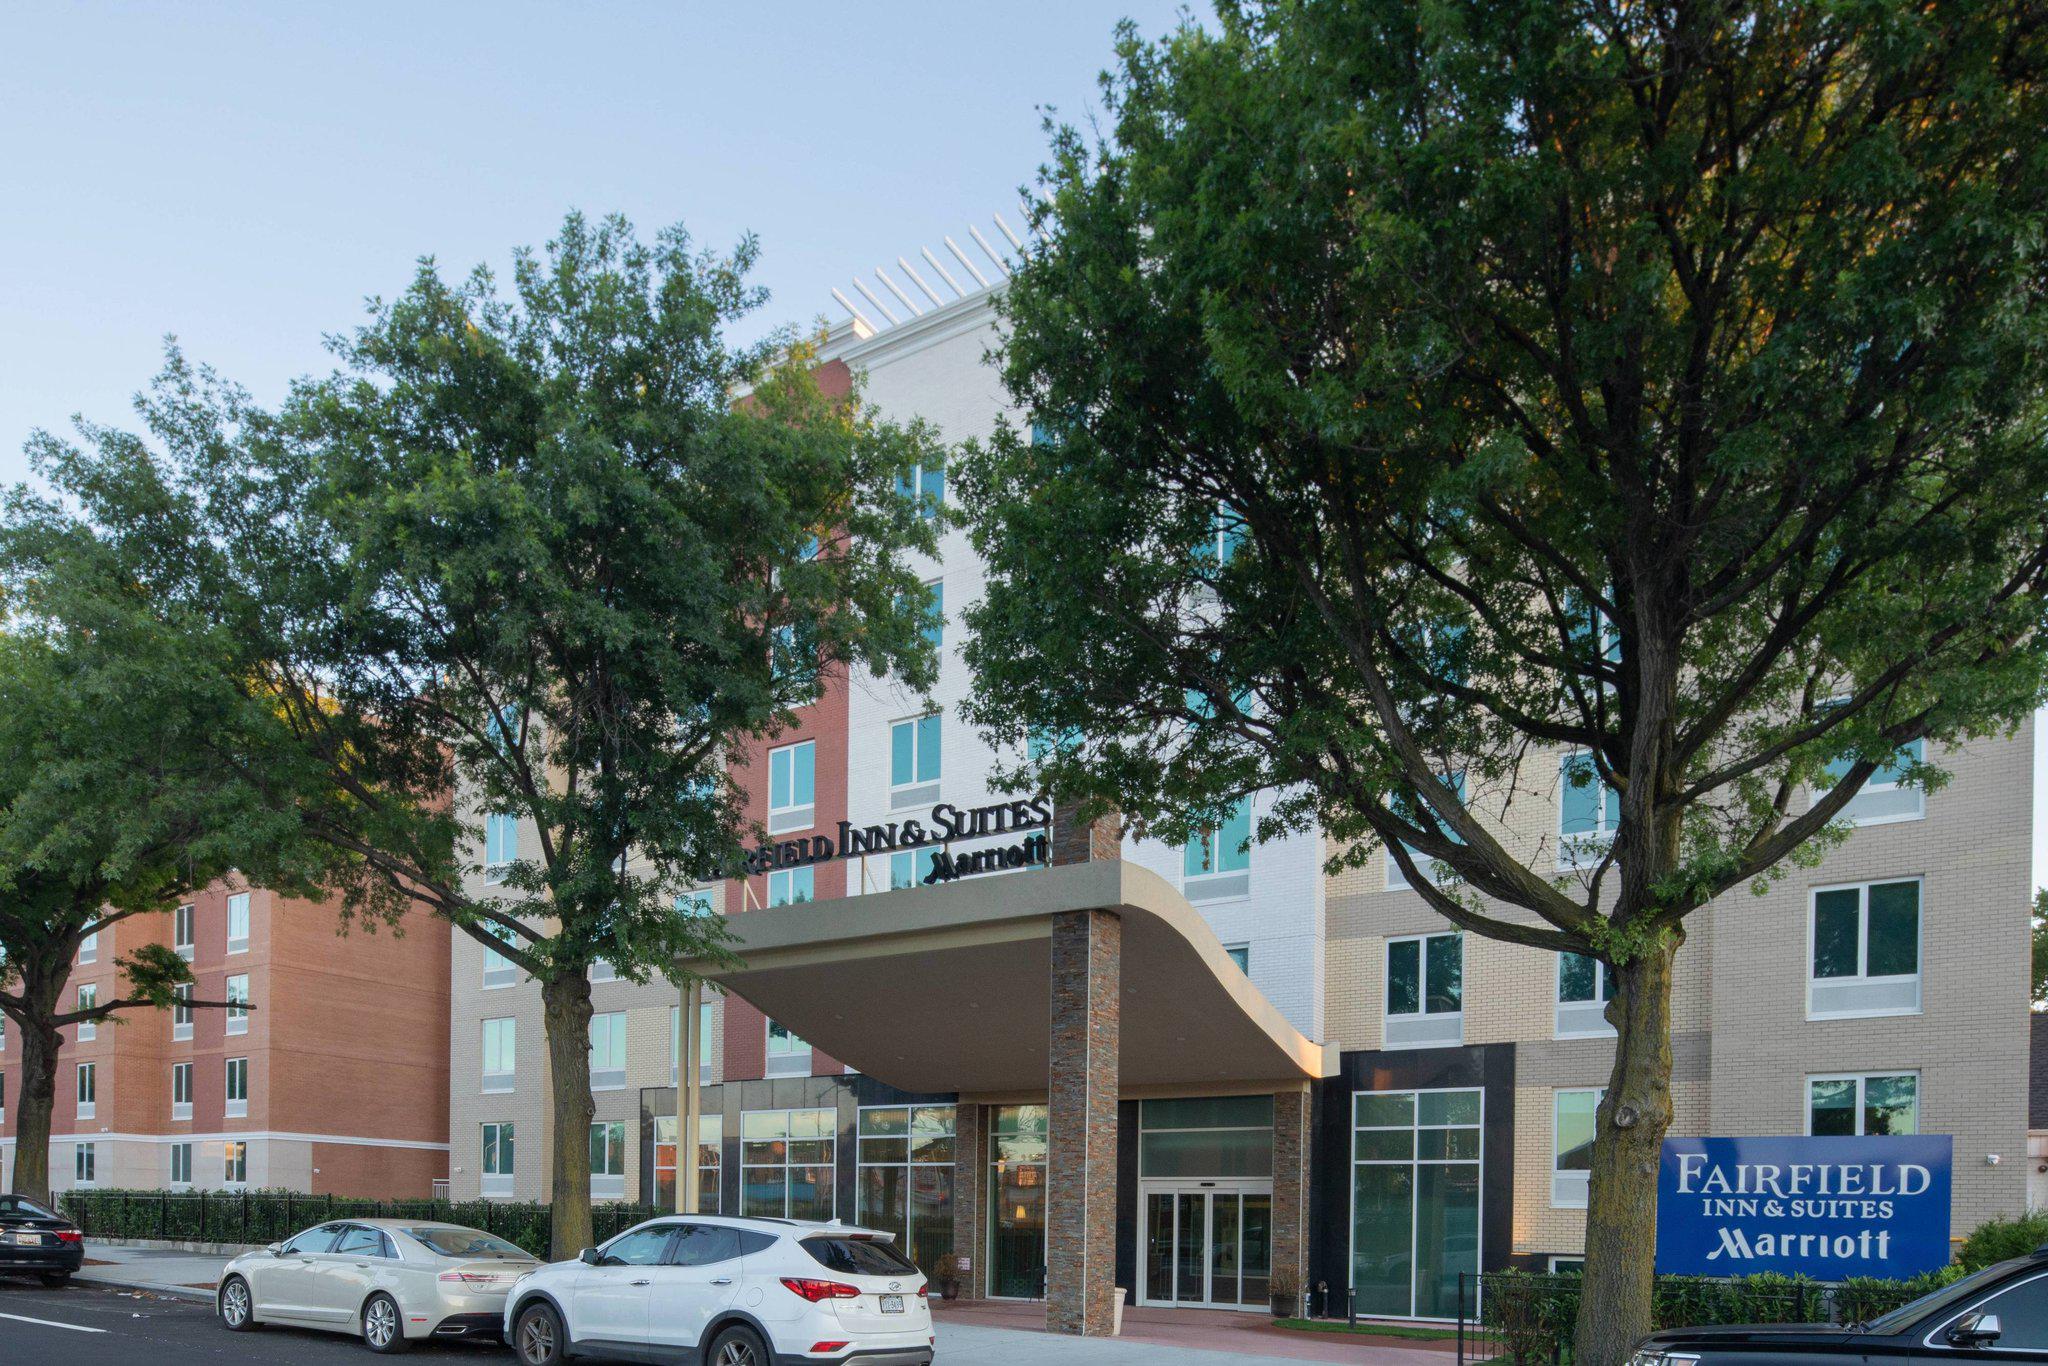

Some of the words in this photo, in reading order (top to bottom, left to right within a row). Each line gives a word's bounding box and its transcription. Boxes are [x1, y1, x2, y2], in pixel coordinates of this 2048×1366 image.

[930, 795, 1051, 843] SUITES
[923, 833, 1049, 885] Marriott
[1675, 1153, 1931, 1199] FAIRFIELD
[1702, 1198, 1759, 1217] INN
[1763, 1198, 1786, 1218] &
[1790, 1199, 1895, 1219] SUITES
[1706, 1226, 1891, 1261] Marriott
